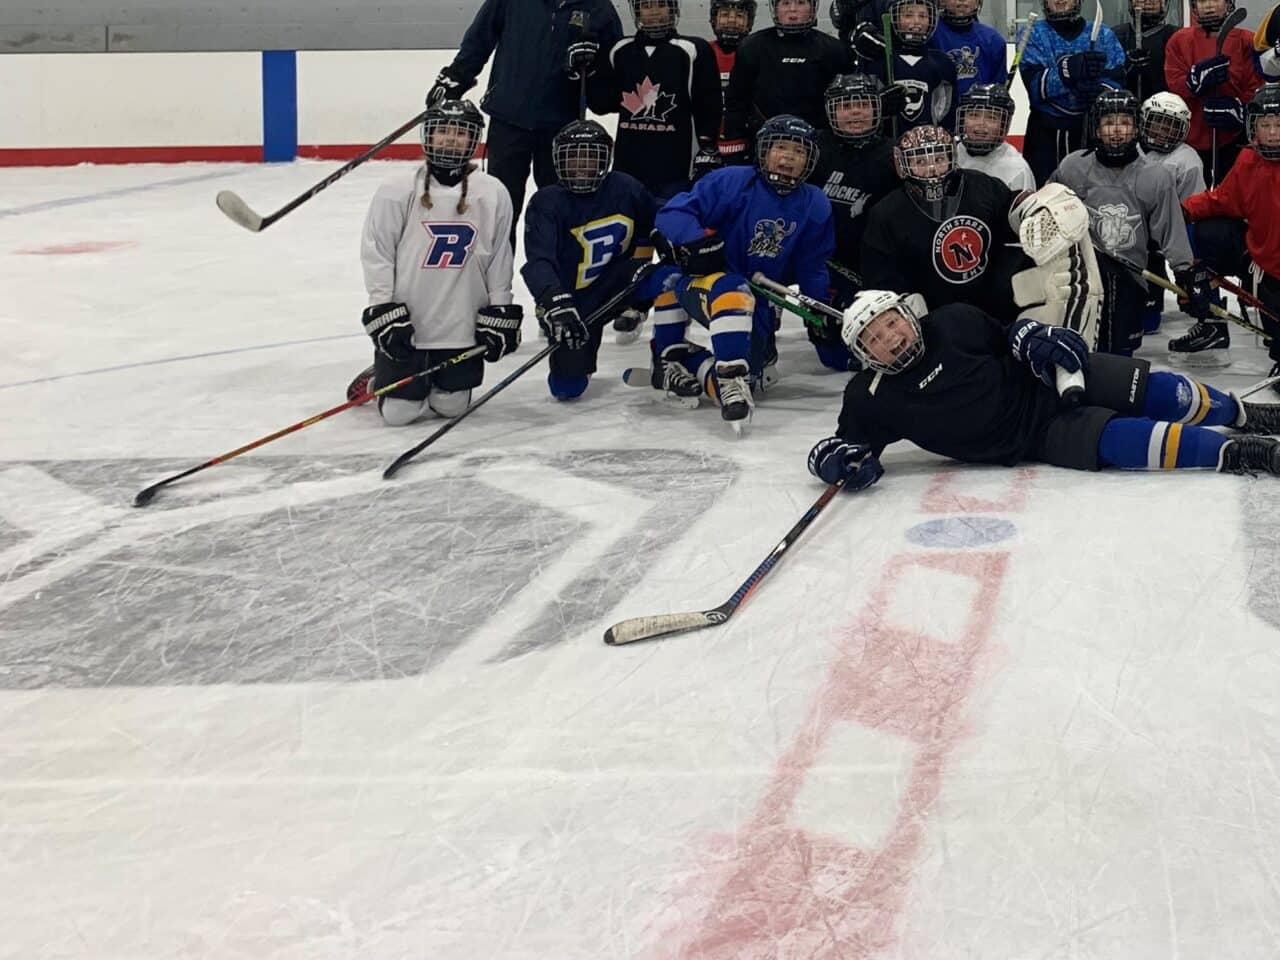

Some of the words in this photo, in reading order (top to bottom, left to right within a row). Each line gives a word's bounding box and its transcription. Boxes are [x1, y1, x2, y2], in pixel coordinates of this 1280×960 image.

[619, 121, 676, 132] CANADA
[421, 221, 478, 269] R
[935, 223, 953, 253] NORTH
[954, 219, 984, 232] STARS
[947, 241, 977, 269] N
[919, 363, 943, 389] CCM
